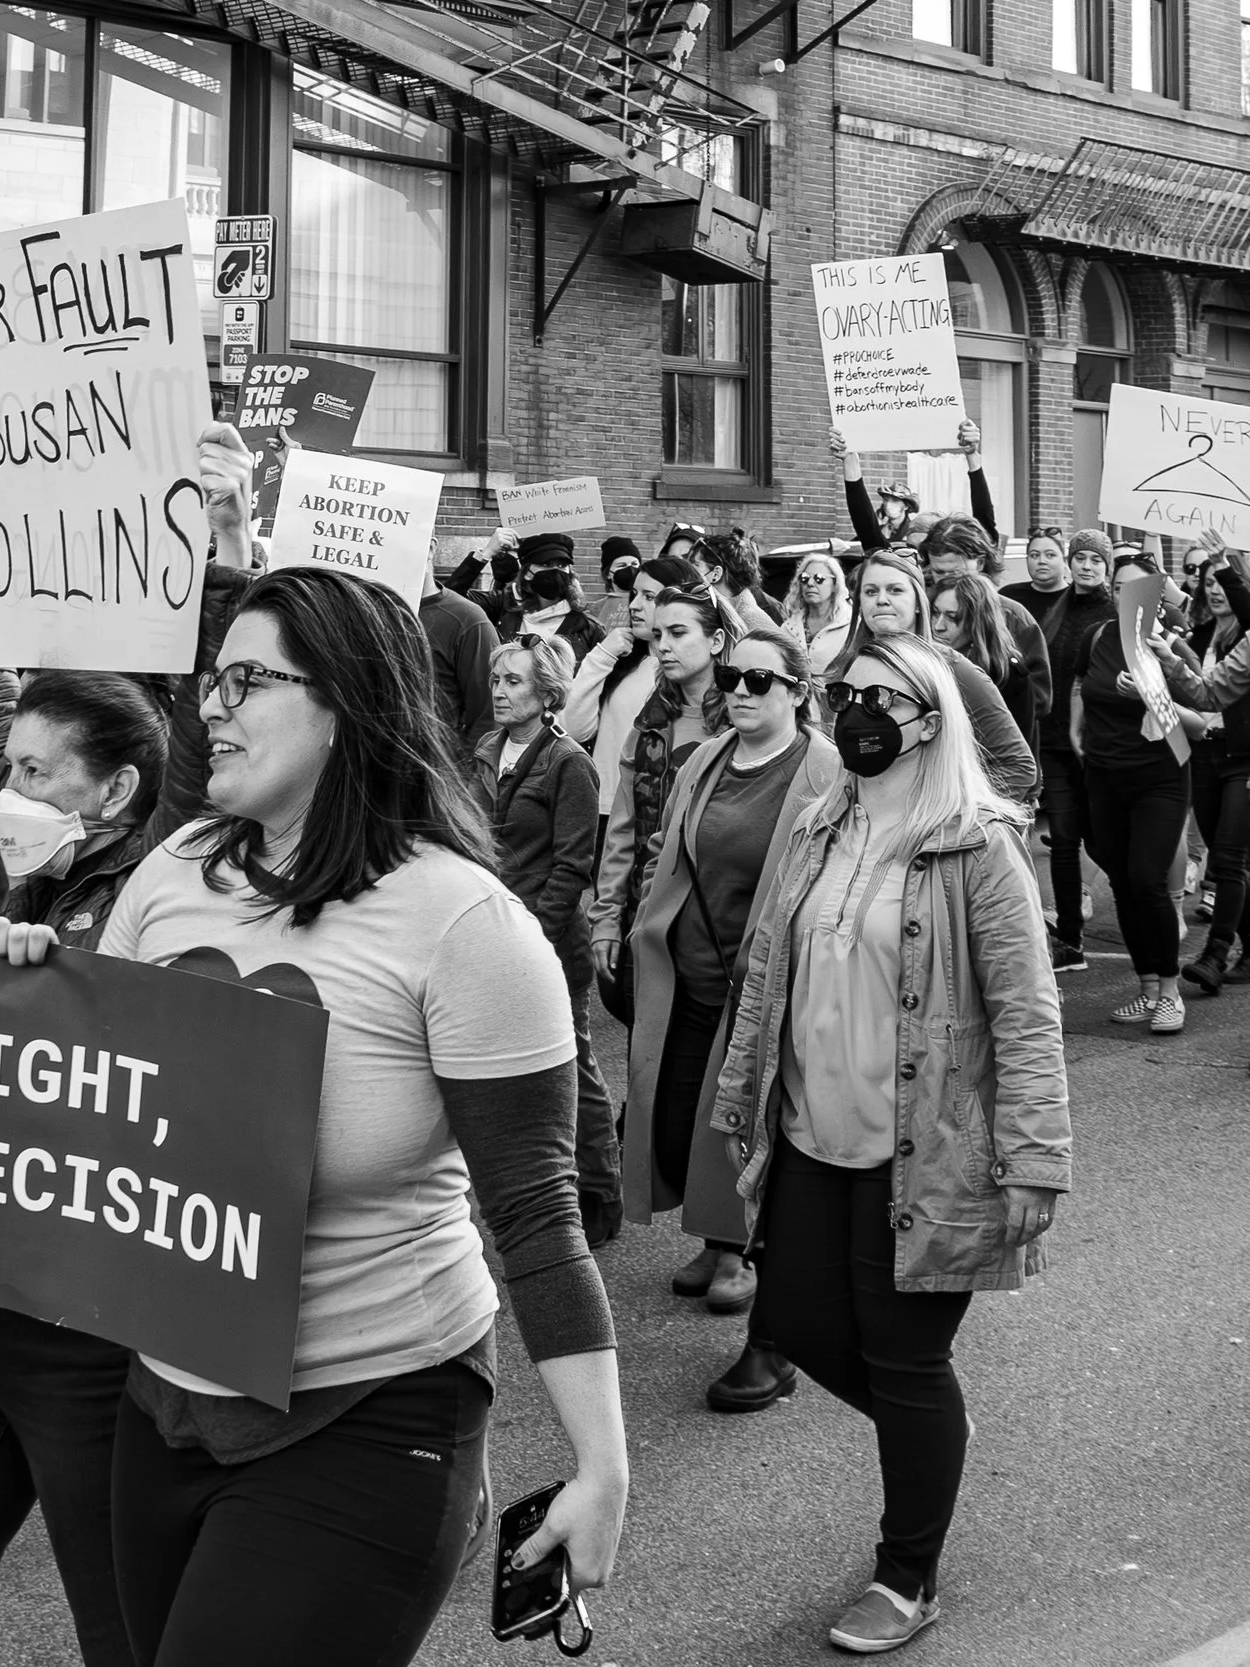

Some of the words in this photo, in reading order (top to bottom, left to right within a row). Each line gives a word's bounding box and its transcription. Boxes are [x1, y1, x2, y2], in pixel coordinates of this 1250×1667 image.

[229, 220, 251, 241] METER
[252, 219, 271, 241] HERE
[255, 245, 266, 264] 2
[21, 231, 183, 344] FAULT
[817, 266, 857, 288] THIS
[869, 265, 886, 285] IS
[895, 261, 926, 283] ME
[822, 299, 950, 340] OVARY-ACTING
[229, 354, 248, 364] 7103
[248, 365, 310, 384] STOP
[245, 386, 286, 406] THE
[239, 407, 298, 428] BANS
[1160, 404, 1250, 446] NEVER
[328, 474, 386, 497] KEEP
[299, 494, 410, 526] ABORTION
[1144, 499, 1236, 534] AGAIN
[313, 520, 365, 543] SAFE
[369, 530, 385, 547] &
[311, 544, 379, 570] LEGAL
